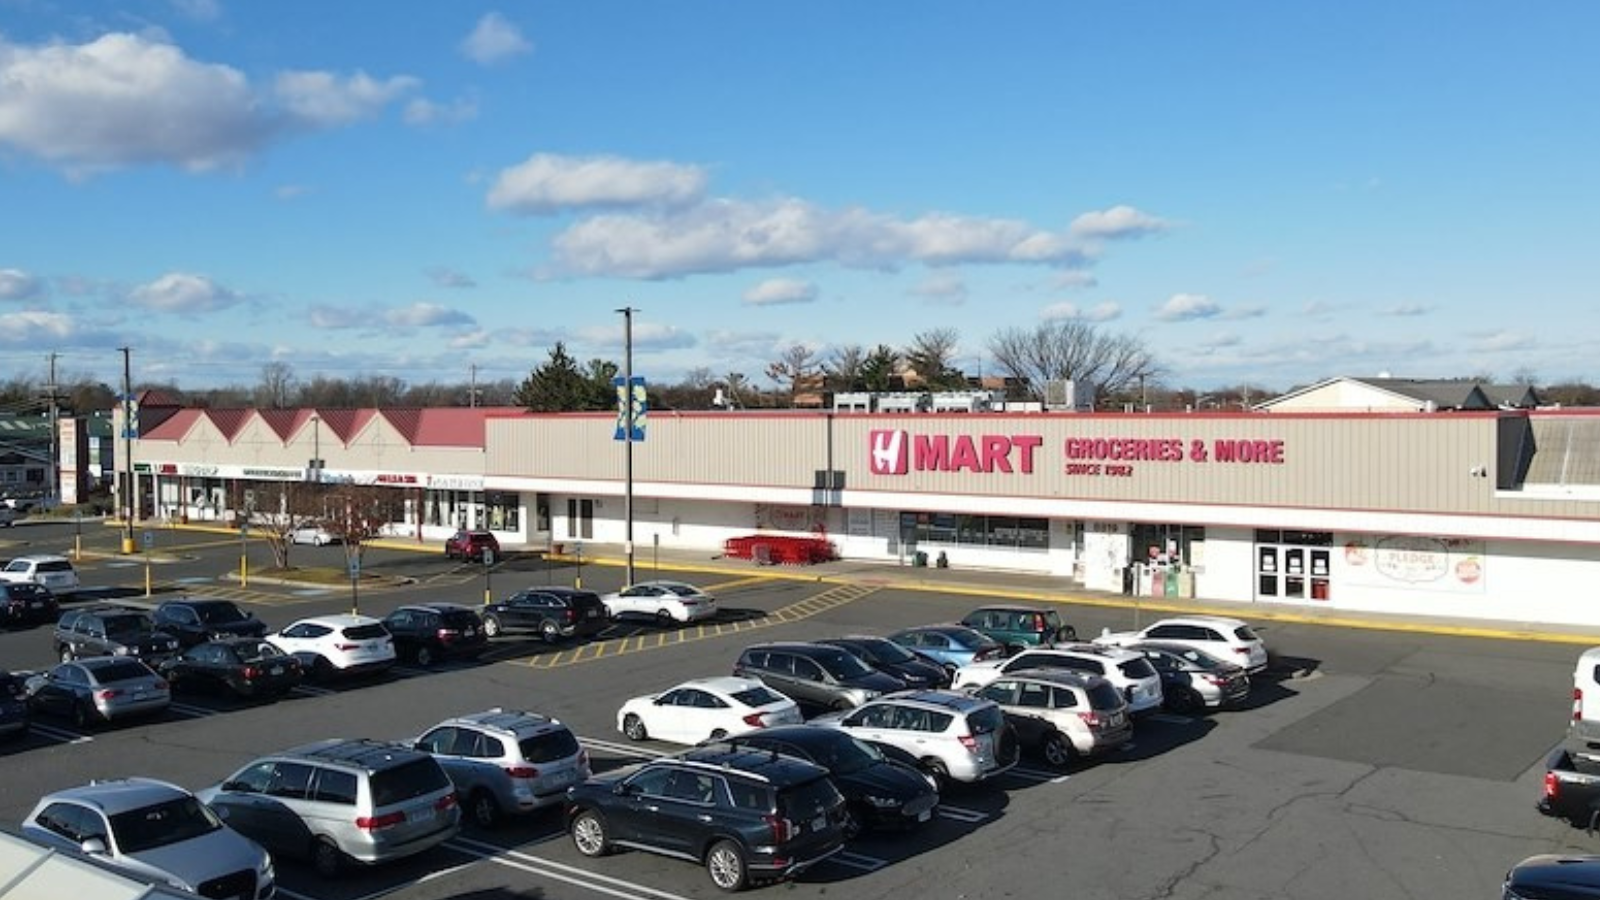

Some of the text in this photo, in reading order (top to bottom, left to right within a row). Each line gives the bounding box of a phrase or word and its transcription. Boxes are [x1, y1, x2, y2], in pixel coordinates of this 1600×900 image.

[872, 430, 1043, 474] H MART
[1065, 438, 1285, 464] GROCERIES & MORE
[1065, 463, 1134, 477] SINCE 1982
